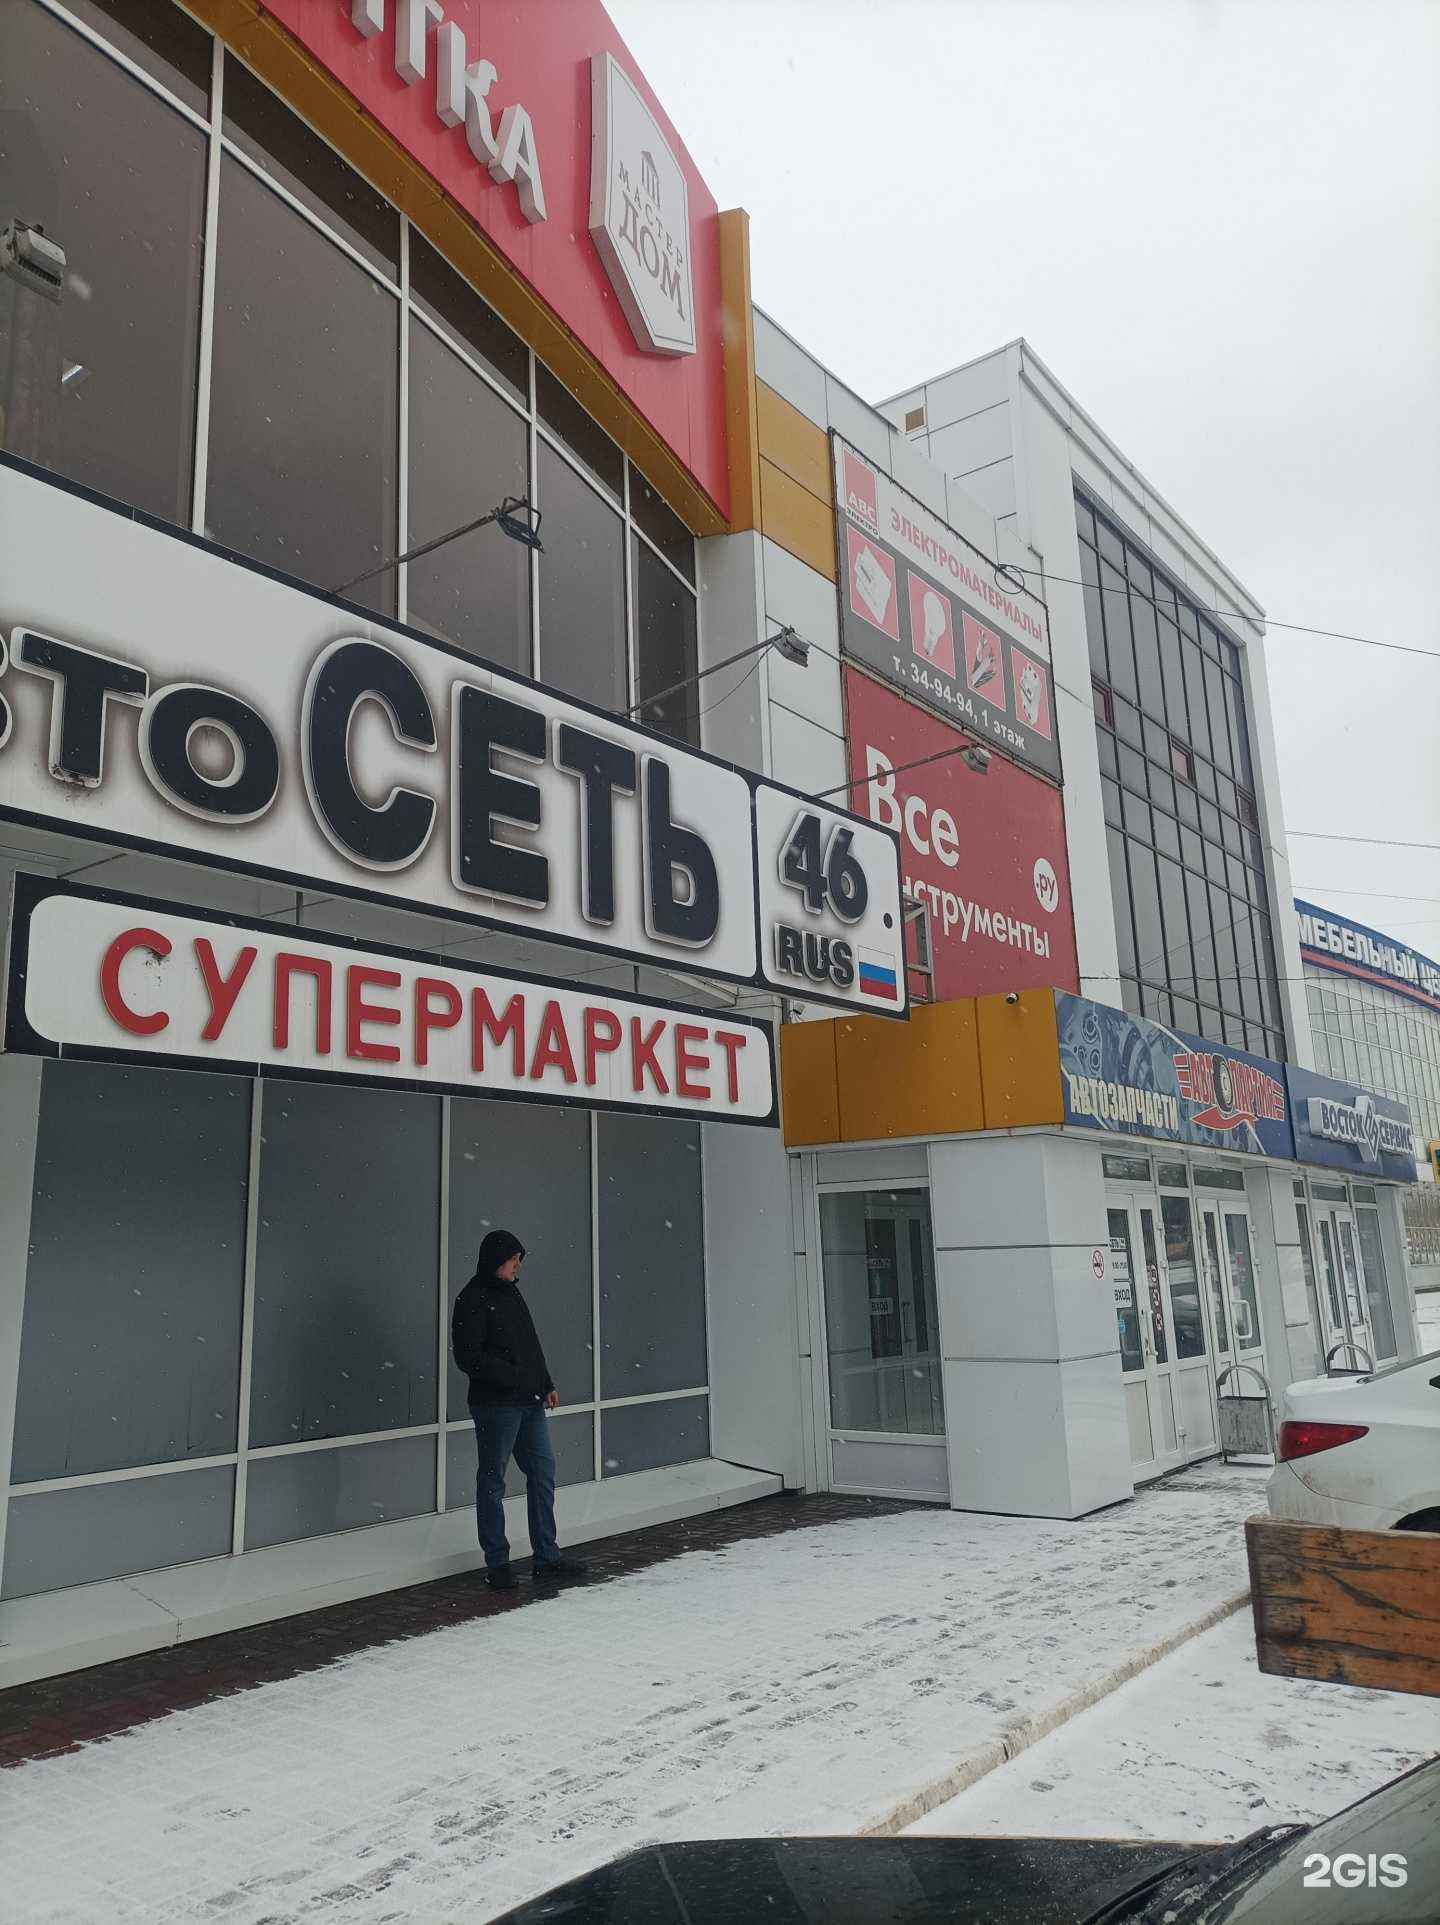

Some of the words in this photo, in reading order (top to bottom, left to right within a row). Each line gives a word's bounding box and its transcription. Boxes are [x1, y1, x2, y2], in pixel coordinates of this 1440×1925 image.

[352, 0, 547, 224] ТКА
[618, 191, 686, 322] ДОМ
[889, 507, 1043, 643] ЭЛЕКТРОМАТЕРИАЛЫ
[0, 626, 720, 949] тоСЕТЬ
[981, 709, 990, 727] 1
[993, 720, 1026, 750] этаж
[866, 744, 961, 867] Все
[778, 809, 869, 925] 46
[774, 921, 856, 990] RUS
[1298, 911, 1419, 986] МЕБЕЛЬНЫЙ
[99, 926, 748, 1104] СУПЕРМАРКЕТ
[1070, 1074, 1179, 1132] АВТОЗАПЧАСТИ
[1320, 1102, 1365, 1142] ВОСТОК
[1379, 1119, 1413, 1152] СЕРВИС
